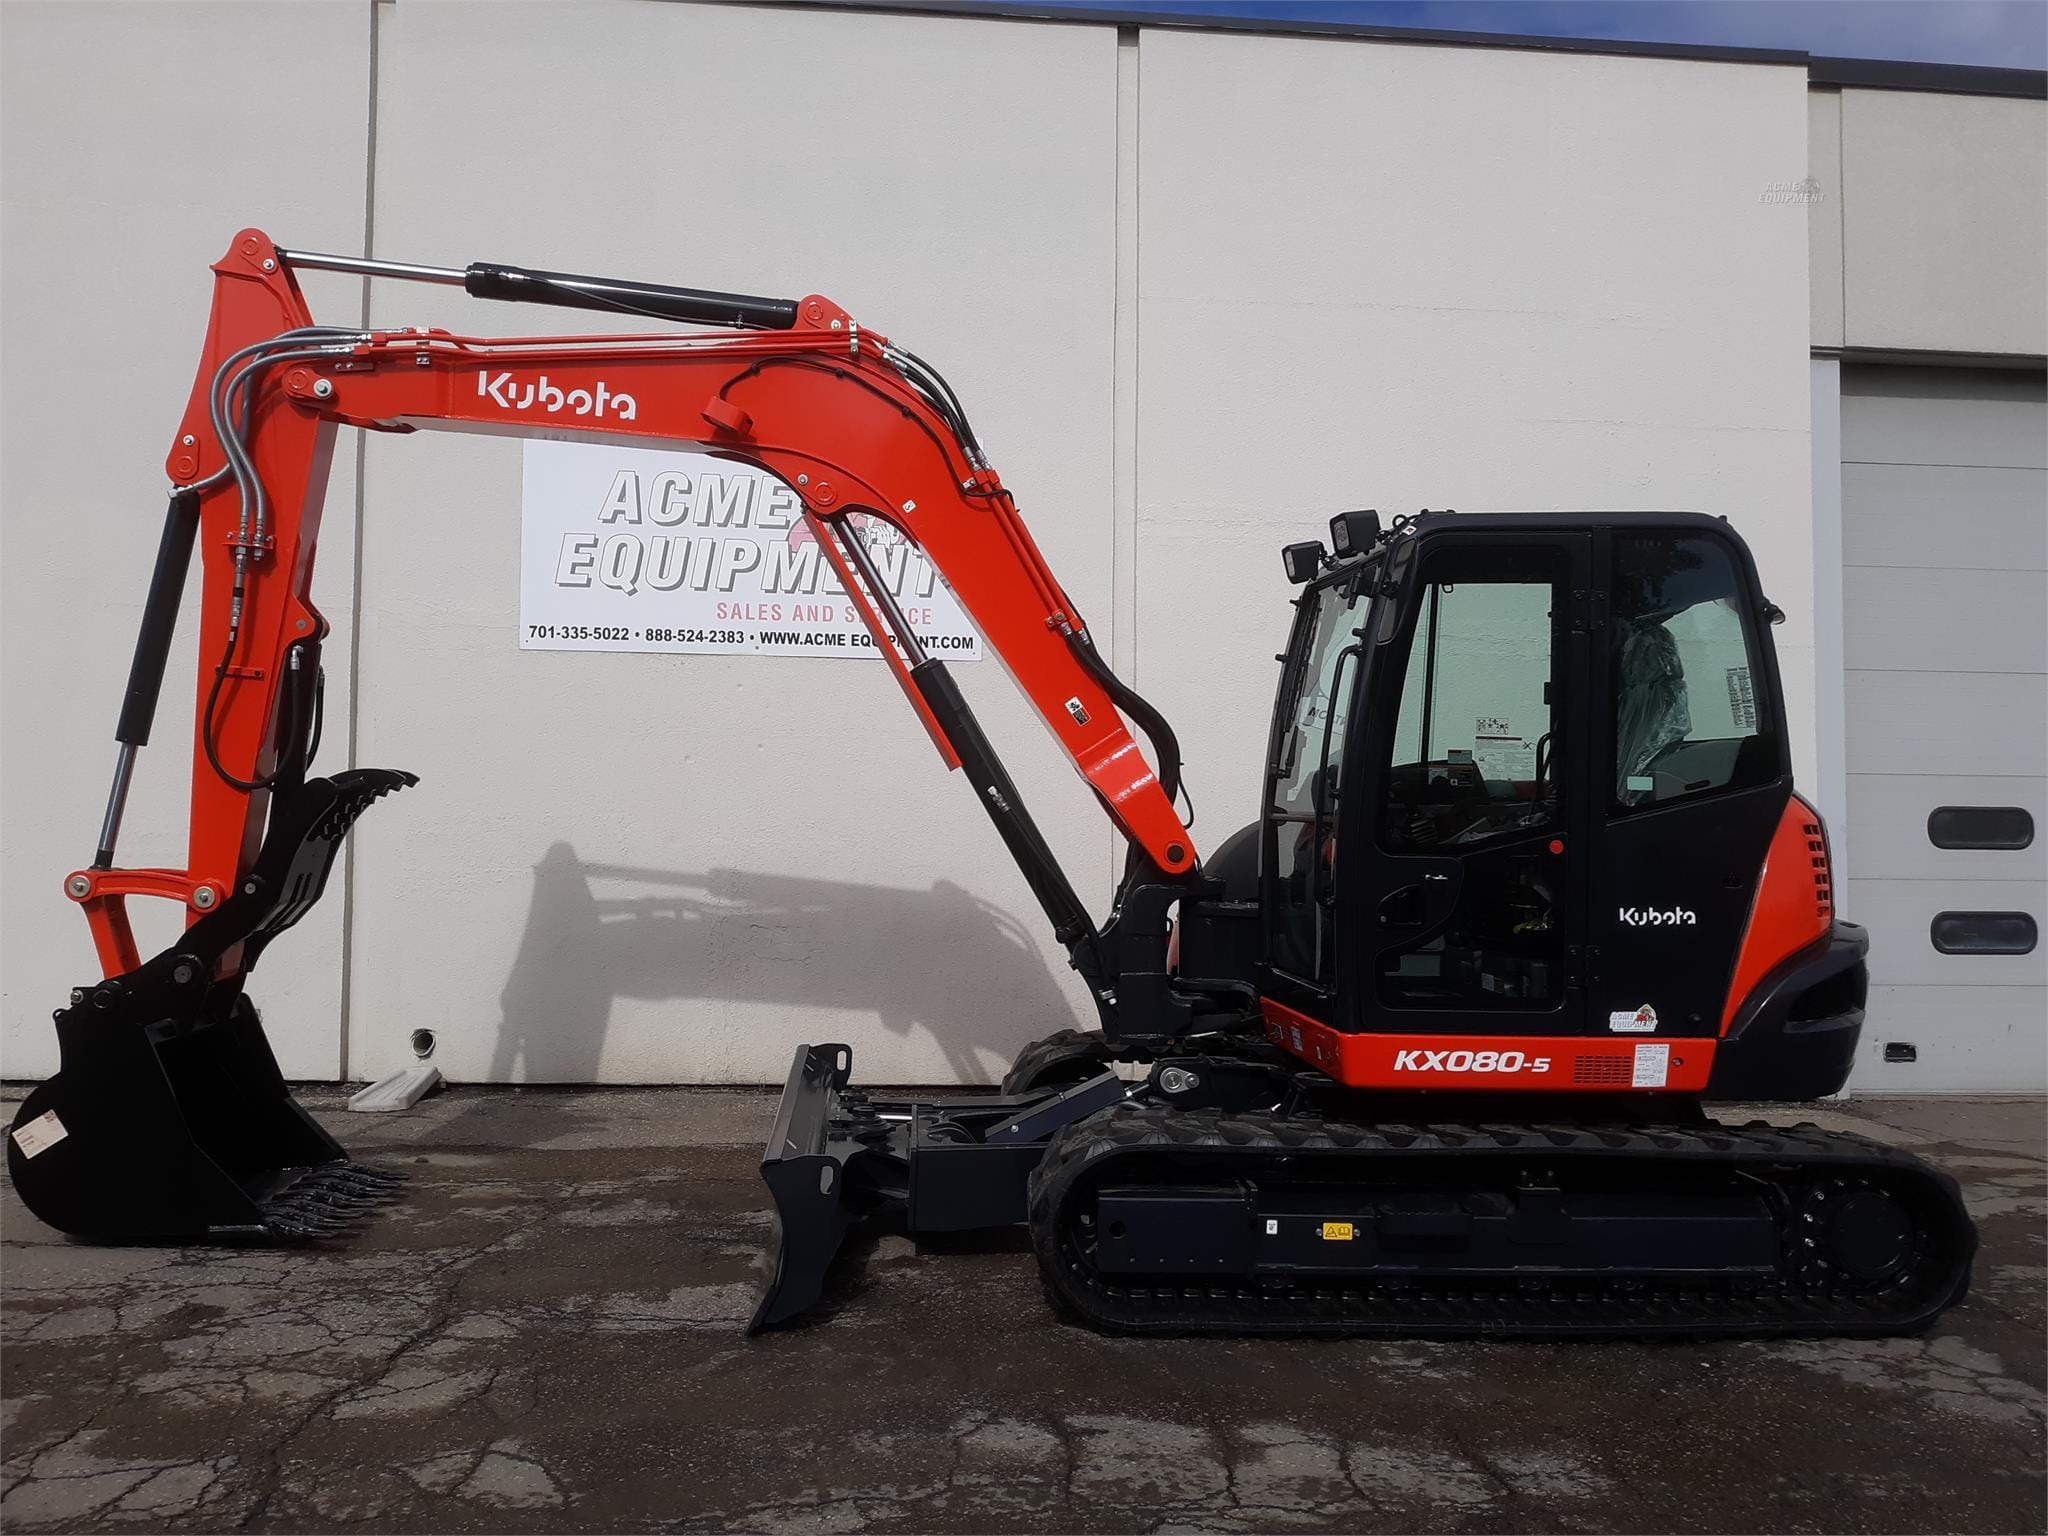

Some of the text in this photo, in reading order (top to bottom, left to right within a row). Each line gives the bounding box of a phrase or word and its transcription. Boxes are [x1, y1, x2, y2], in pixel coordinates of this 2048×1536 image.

[477, 370, 637, 420] Kubota
[597, 470, 793, 530] ACME
[716, 602, 782, 621] SALES
[792, 604, 834, 622] AND
[528, 625, 630, 641] 701-335-5022
[645, 628, 745, 644] 888-524-2383
[759, 631, 846, 646] WWW.ACME
[1619, 906, 1696, 926] Kubota
[1393, 1050, 1552, 1073] KX080-5
